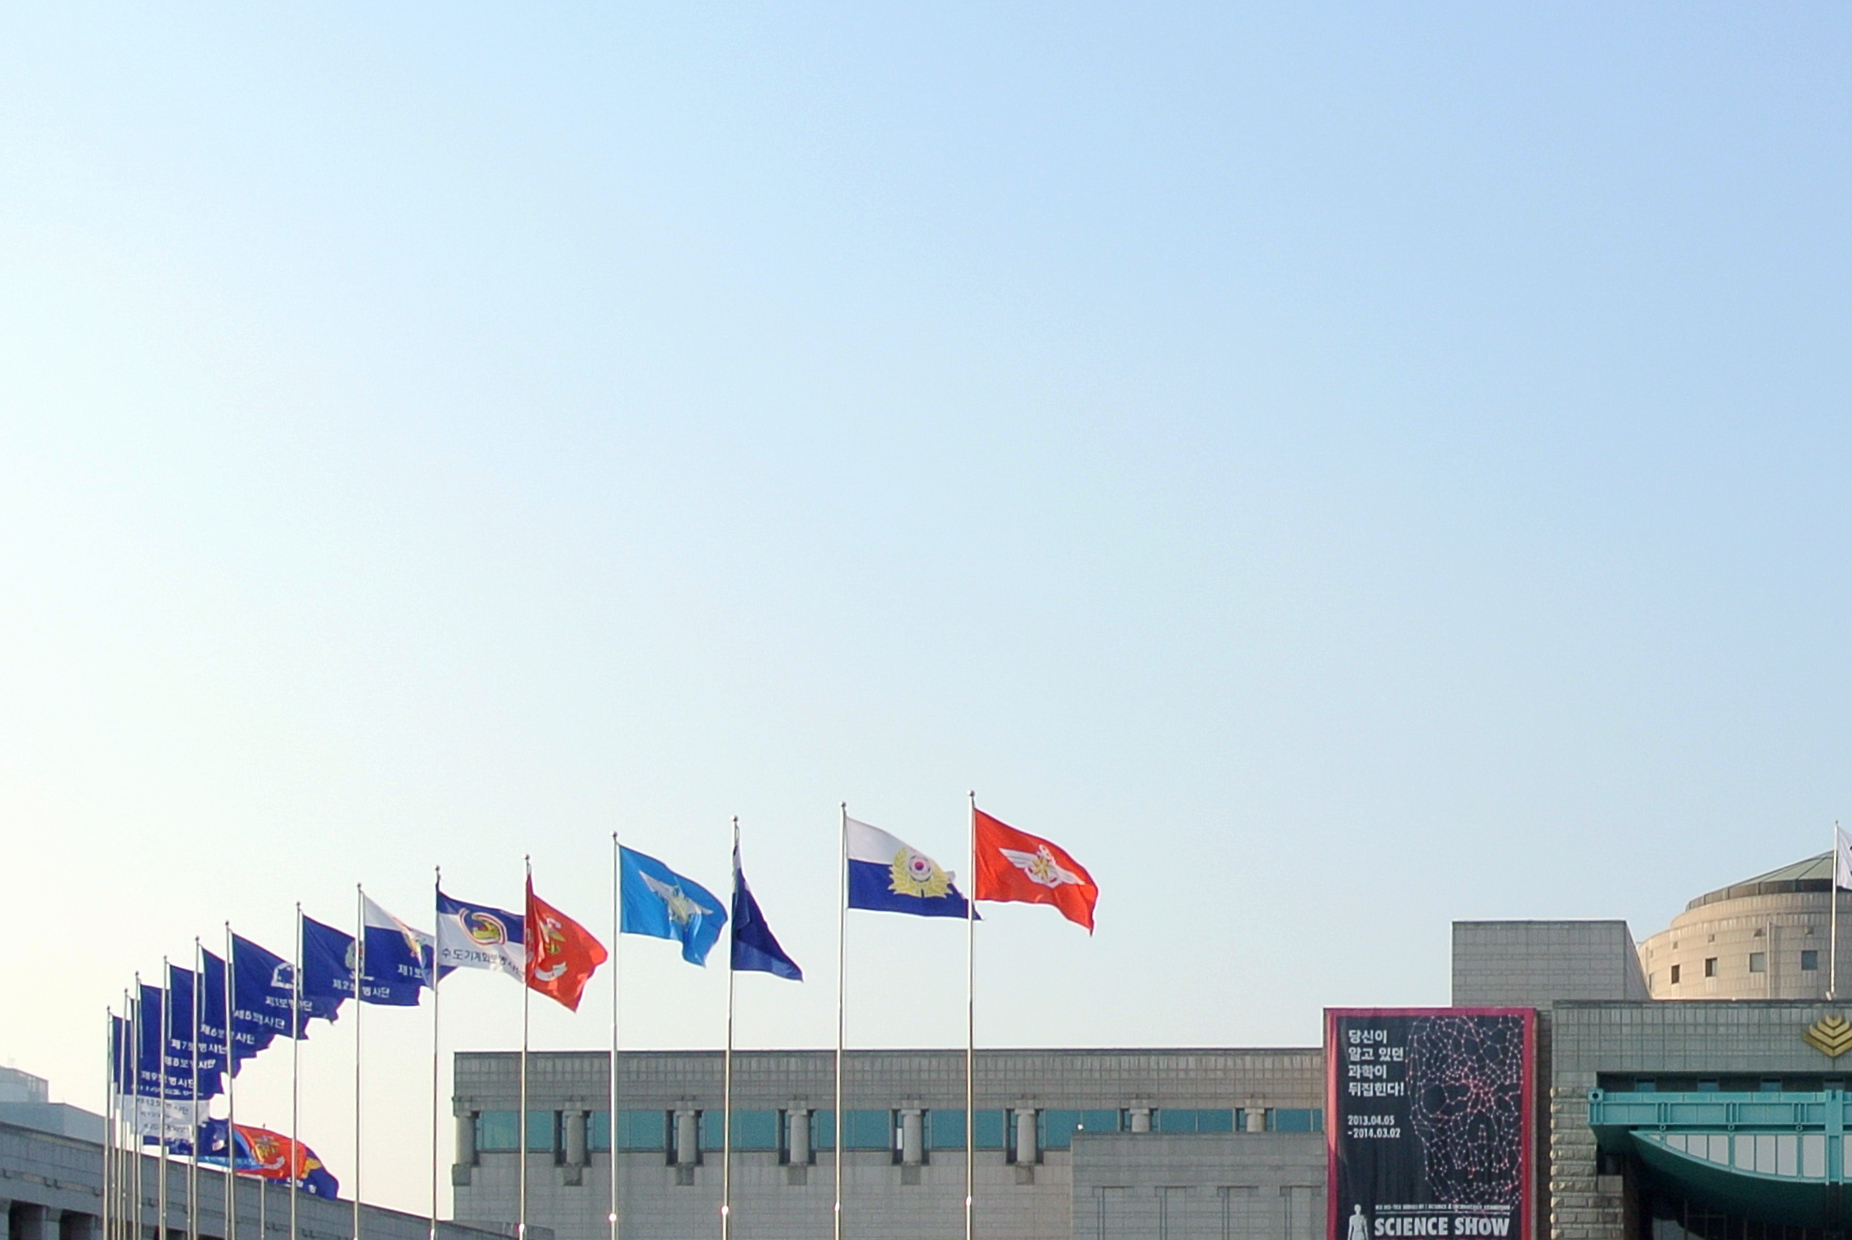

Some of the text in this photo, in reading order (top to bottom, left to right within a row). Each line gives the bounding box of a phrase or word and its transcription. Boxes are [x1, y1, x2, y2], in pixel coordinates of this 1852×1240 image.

[200, 1023, 255, 1045] 제6보사단
[1348, 1029, 1388, 1044] 당신이
[1348, 1046, 1404, 1061] 알고 있던
[164, 1056, 217, 1070] 제8보사단
[1347, 1064, 1387, 1079] 과학이
[1348, 1081, 1405, 1097] 뒤집힌다!
[1347, 1115, 1395, 1126] 2013.04.05
[1374, 1217, 1510, 1237] SCIENCE SHOW
